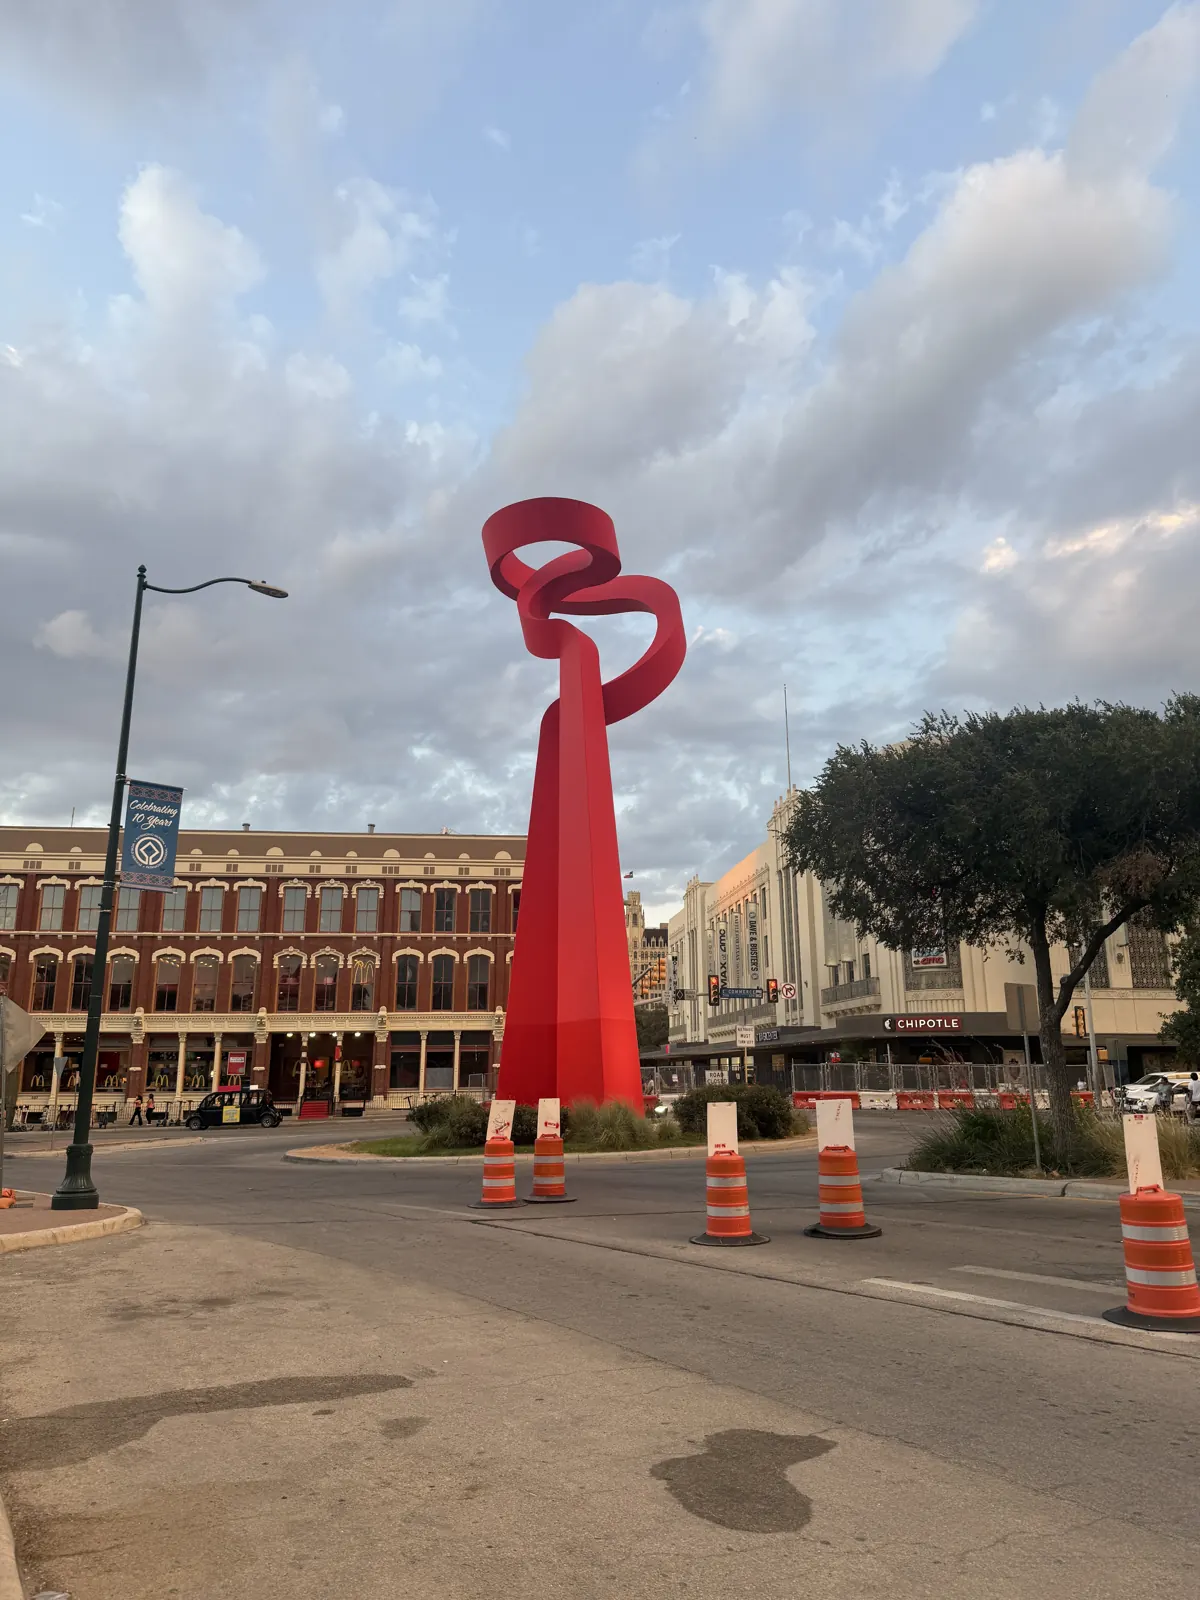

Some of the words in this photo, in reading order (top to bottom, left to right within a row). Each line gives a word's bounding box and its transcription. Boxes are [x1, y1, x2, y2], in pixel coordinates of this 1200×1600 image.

[129, 799, 178, 817] Celebrating
[132, 813, 145, 823] 10
[141, 815, 173, 830] Years
[749, 920, 757, 935] DAVE
[750, 943, 758, 972] BUSTER'S
[897, 1019, 959, 1029] CHIPOTLE
